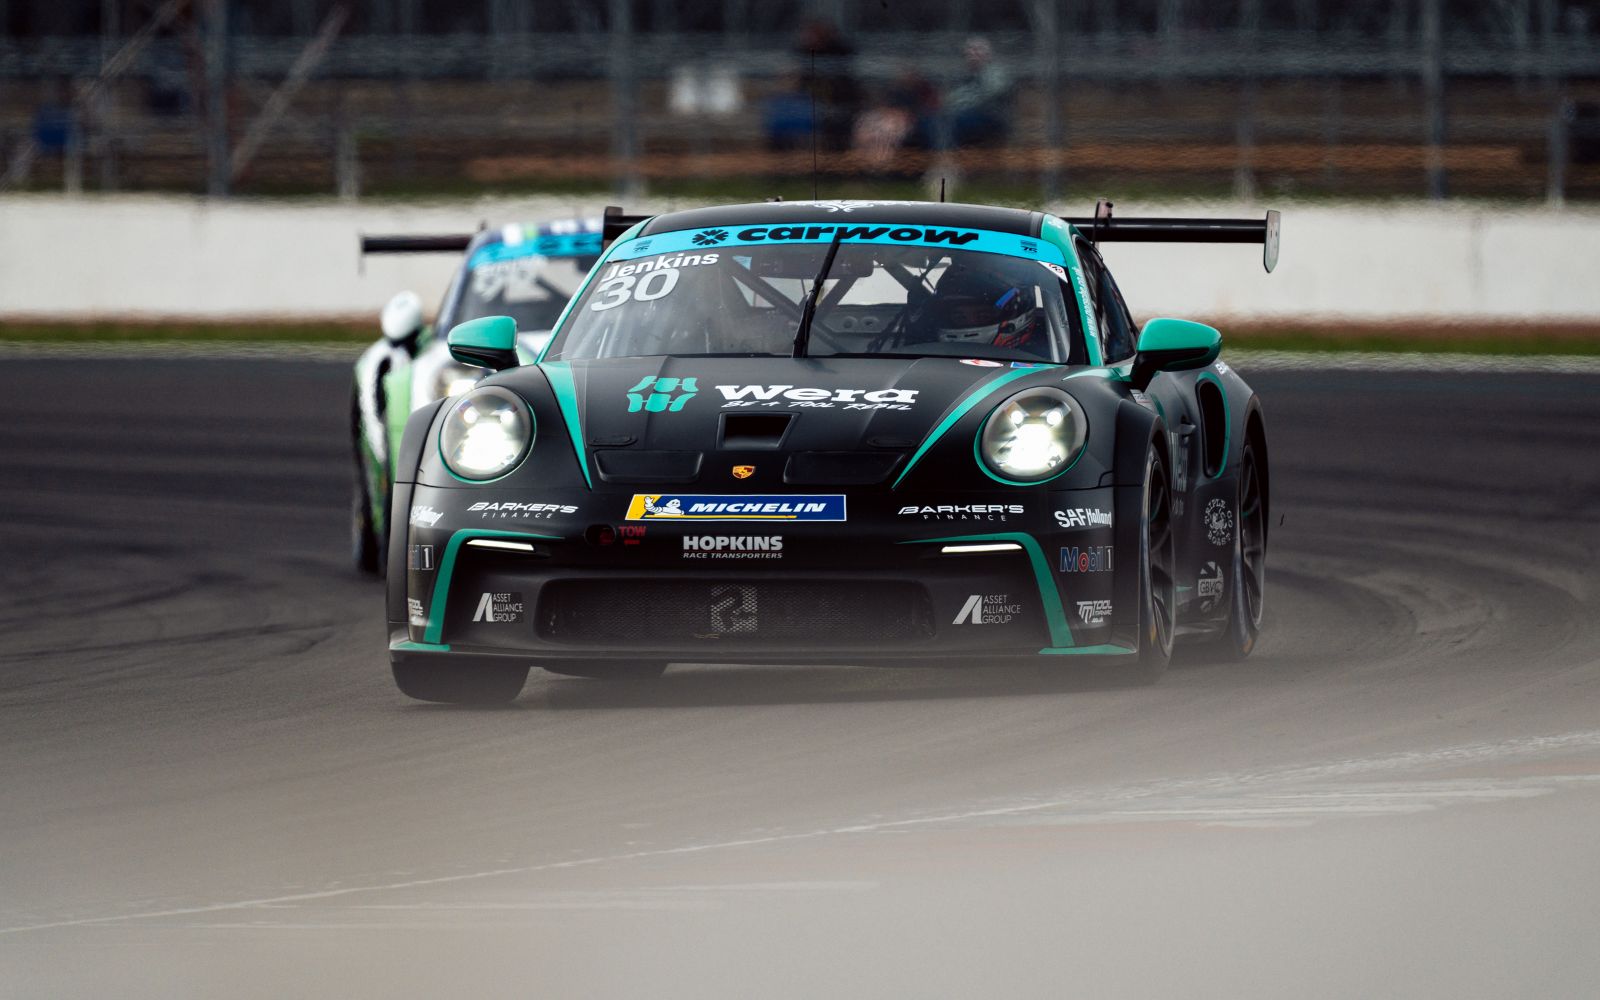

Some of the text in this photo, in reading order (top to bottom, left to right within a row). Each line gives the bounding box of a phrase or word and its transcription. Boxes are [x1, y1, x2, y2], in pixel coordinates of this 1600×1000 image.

[737, 226, 979, 246] carwow
[602, 253, 720, 282] Jenkins
[590, 268, 680, 312] 30
[715, 385, 919, 403] Wera
[842, 403, 911, 411] REBEL
[467, 502, 579, 514] BARKER'S
[689, 503, 827, 512] MICHELIN
[898, 504, 1025, 515] BARKER'S
[1054, 508, 1087, 528] SAF
[619, 525, 646, 537] TOW
[683, 535, 783, 550] HOPKINS
[1060, 546, 1104, 573] Mobil
[493, 593, 511, 602] ASSET
[983, 595, 1007, 604] ASSET
[493, 603, 523, 613] ALLIANCE
[983, 605, 1021, 614] ALLIANCE
[493, 613, 517, 623] GROUP
[982, 615, 1012, 624] GROUP
